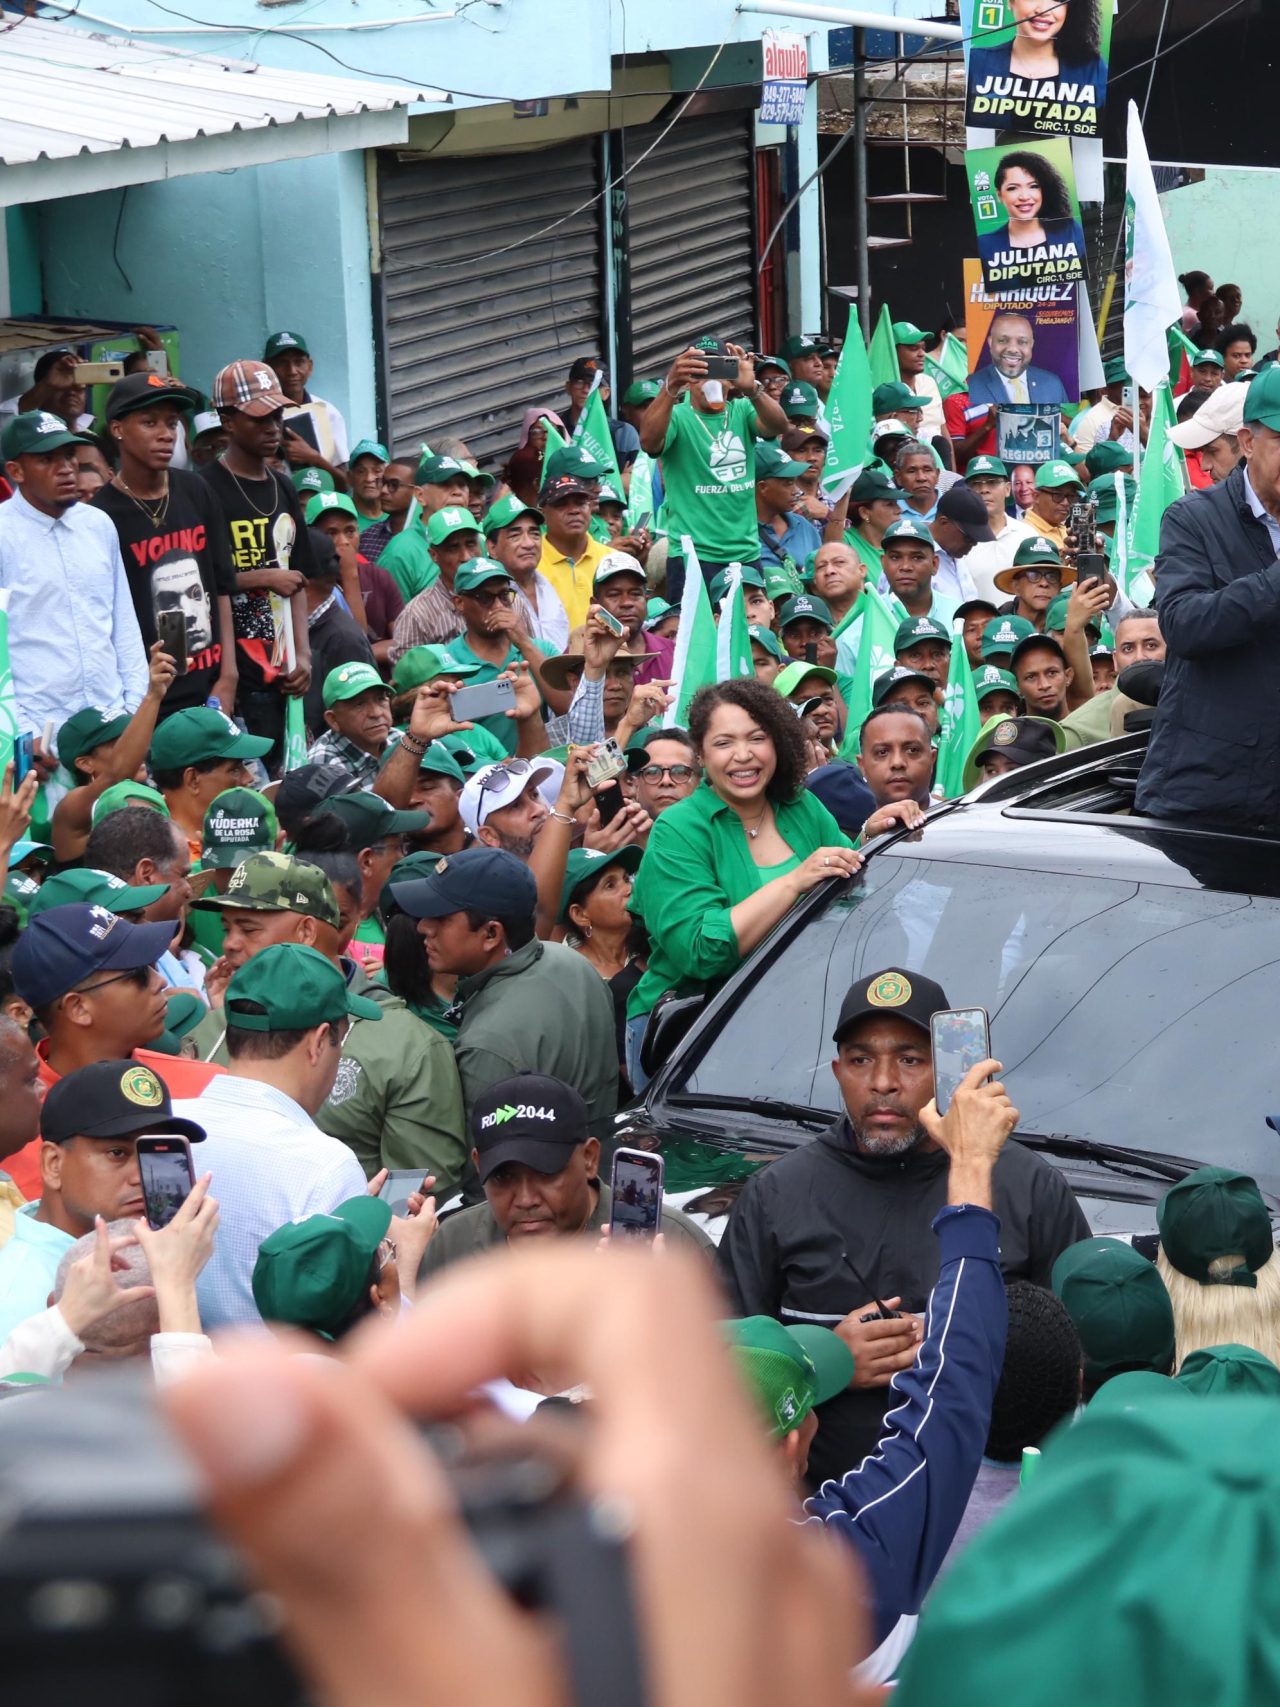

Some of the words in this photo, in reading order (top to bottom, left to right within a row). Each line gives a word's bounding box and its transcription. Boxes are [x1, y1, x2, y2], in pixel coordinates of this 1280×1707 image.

[985, 7, 996, 25] 1
[766, 42, 807, 79] alquila
[975, 75, 1096, 104] JULIANA
[972, 96, 1097, 123] DIPUTADA
[1034, 120, 1071, 134] CIRC.1,
[1073, 124, 1097, 135] SDE
[982, 202, 991, 216] 1
[988, 242, 1078, 267] JULIANA
[989, 258, 1082, 281] DIPUTADA
[1066, 271, 1083, 280] SDE
[983, 302, 1033, 310] DIPUTADO
[1041, 436, 1049, 445] 3
[582, 431, 615, 471] FUERZA
[1003, 449, 1050, 460] REGIDOR
[715, 465, 745, 480] FP
[695, 485, 729, 494] FUERZA
[730, 482, 745, 493] DEL
[130, 524, 206, 567] YOUNG
[992, 634, 1019, 642] LEONEL
[209, 817, 260, 829] YUDERKA
[234, 828, 255, 836] ROSA
[481, 1112, 497, 1129] RD
[515, 1104, 556, 1121] 2044
